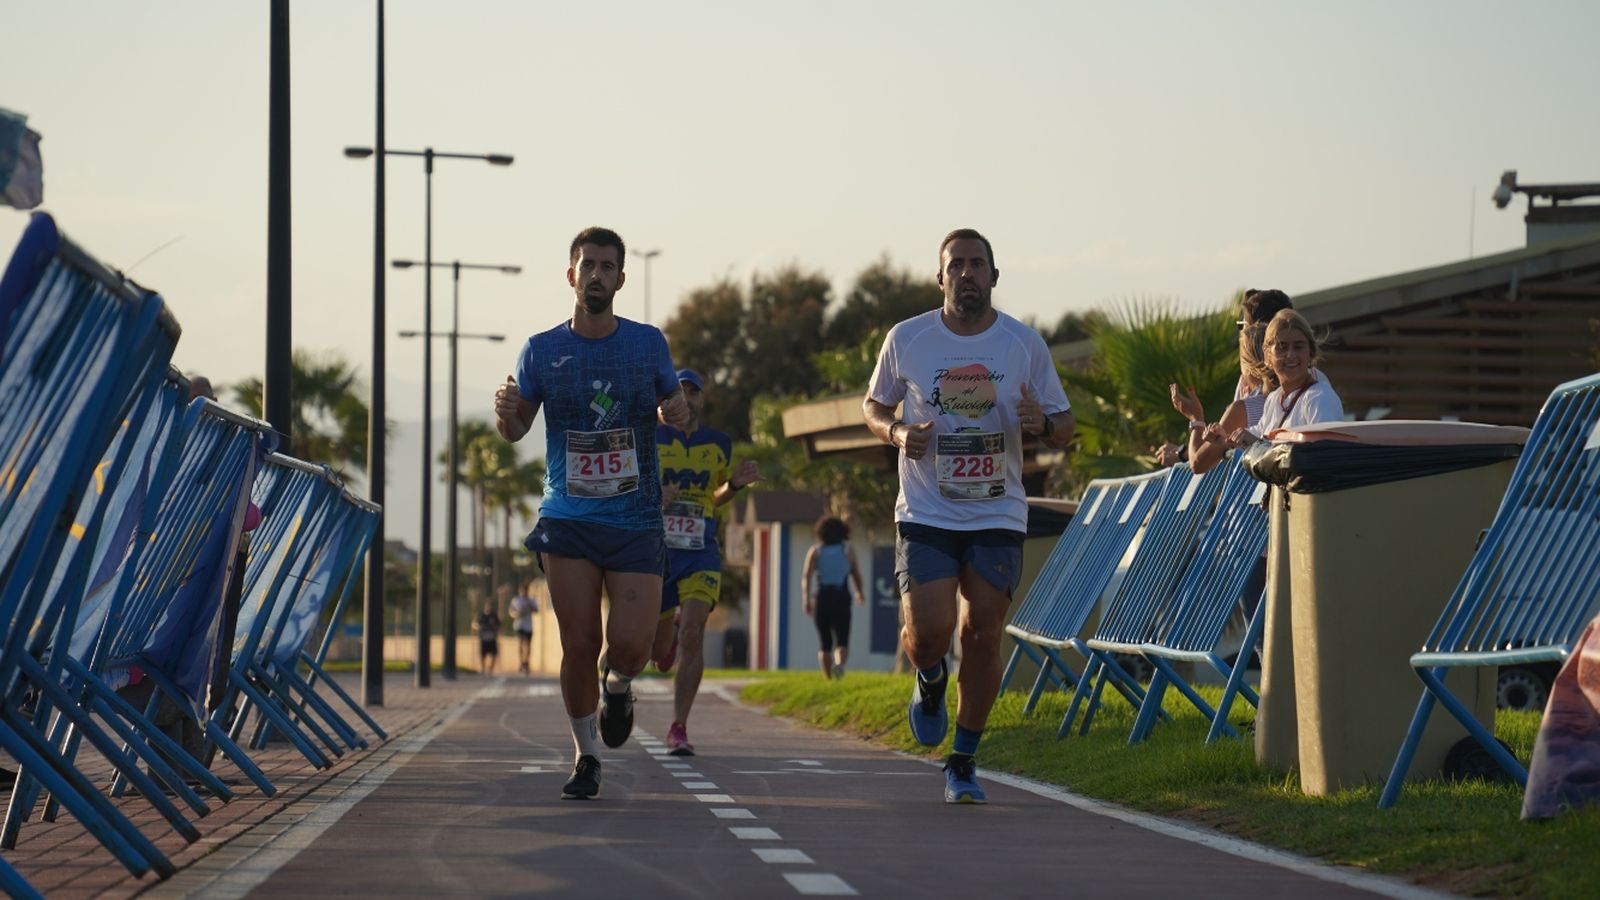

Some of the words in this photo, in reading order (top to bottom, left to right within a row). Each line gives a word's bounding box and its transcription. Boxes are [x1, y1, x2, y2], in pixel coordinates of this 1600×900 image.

[580, 452, 622, 476] 215
[952, 455, 994, 477] 228
[667, 517, 696, 534] 212
